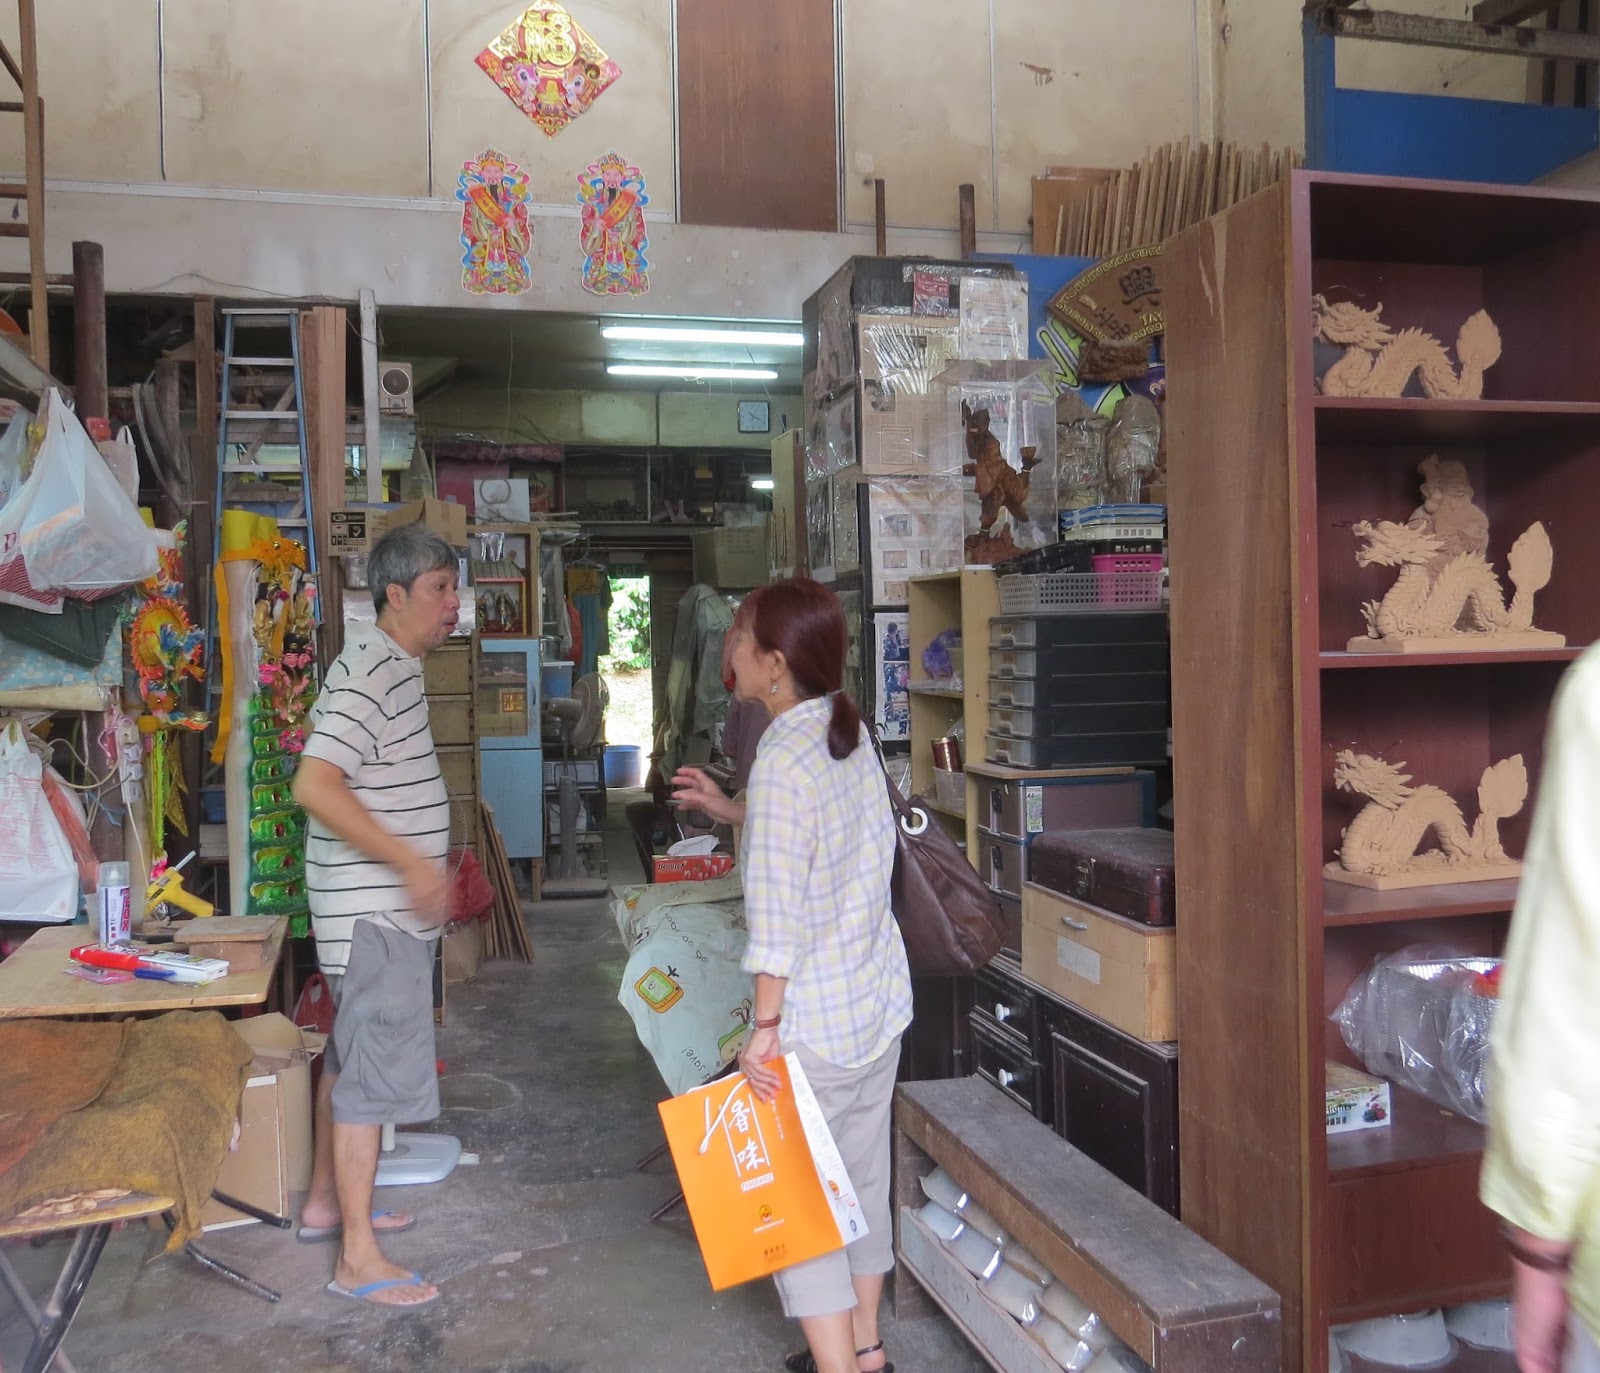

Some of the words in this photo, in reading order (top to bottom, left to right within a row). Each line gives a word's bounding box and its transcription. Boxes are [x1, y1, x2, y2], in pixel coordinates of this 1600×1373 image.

[521, 10, 576, 66] 福
[1140, 311, 1163, 326] TAY
[681, 1046, 706, 1072] save!
[729, 1098, 765, 1171] 香味
